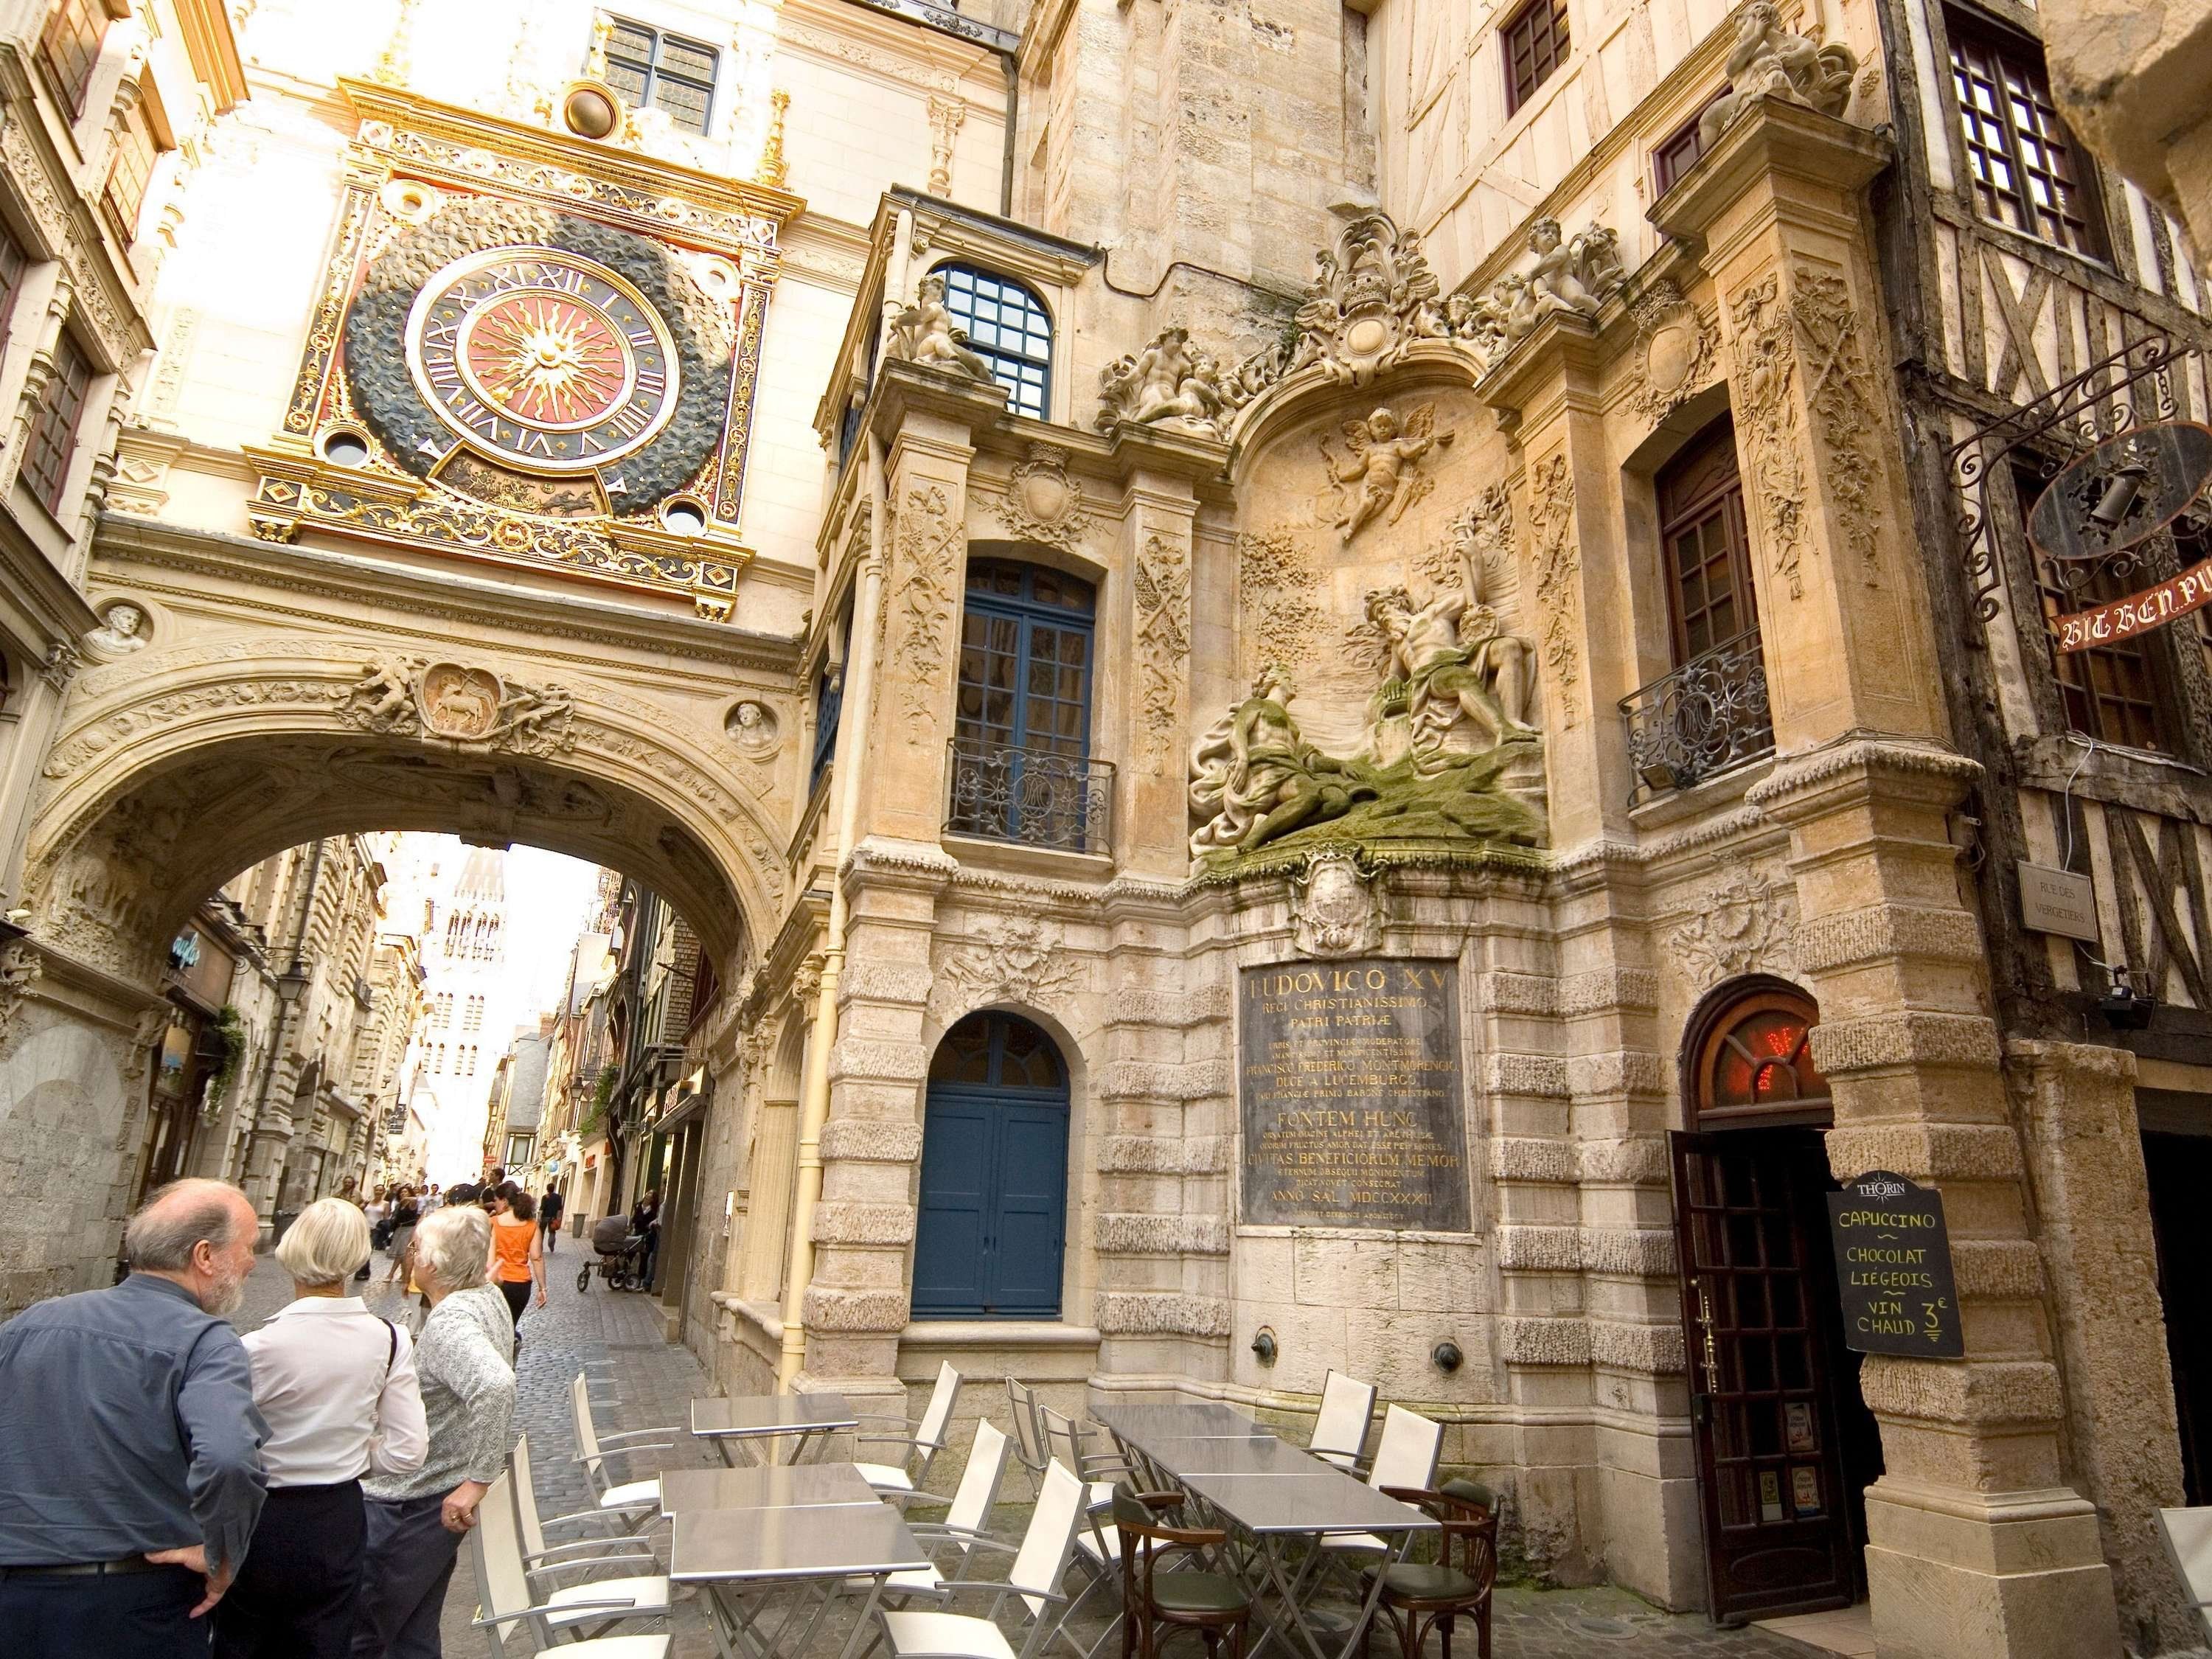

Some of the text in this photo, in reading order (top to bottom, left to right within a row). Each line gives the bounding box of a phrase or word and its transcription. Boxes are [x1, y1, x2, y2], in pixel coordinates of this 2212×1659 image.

[2062, 610, 2110, 650] BIG
[2114, 588, 2179, 634] BEN
[2040, 882, 2076, 899] RUE DES
[1251, 969, 1448, 998] LUDOVICO XV
[1294, 996, 1427, 1010] CHRISTIANISSIMO
[1291, 1017, 1329, 1028] PATRI
[1276, 1076, 1304, 1088] DUCE
[1310, 1077, 1318, 1087] A
[1278, 1110, 1417, 1127] FONTEM HUNC
[1298, 1152, 1399, 1165] BENEFICIORUM
[1405, 1154, 1458, 1167] MEMOR
[1272, 1190, 1304, 1202] ANNO
[1857, 1182, 1905, 1195] THORIN
[1839, 1211, 1935, 1228] CAPUCCINO
[1846, 1247, 1927, 1264] CHOCOLAT
[1868, 1301, 1902, 1315] VIN
[1857, 1317, 1915, 1335] CHAUD
